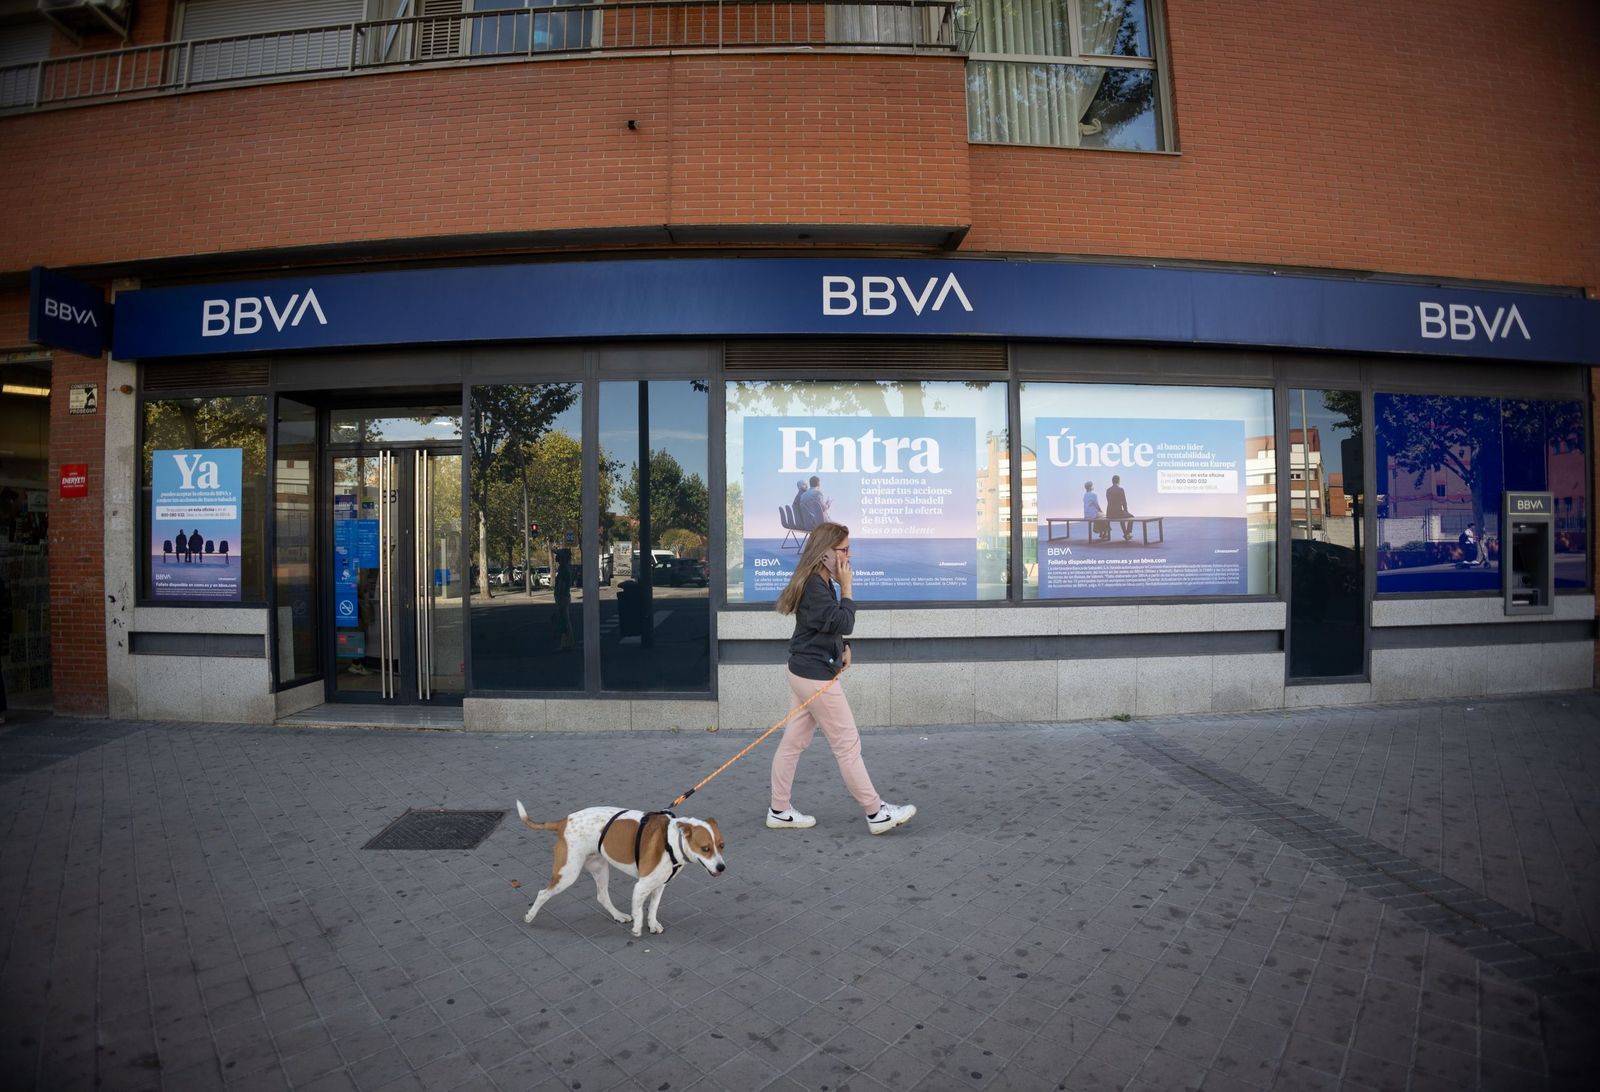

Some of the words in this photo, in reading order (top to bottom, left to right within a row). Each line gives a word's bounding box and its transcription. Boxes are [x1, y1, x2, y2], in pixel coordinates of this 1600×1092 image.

[822, 272, 974, 318] BBVA
[45, 297, 98, 328] BBVA
[201, 287, 328, 338] BBVA
[1419, 301, 1531, 342] BBVA
[778, 427, 944, 474] Entra
[1046, 427, 1154, 468] Únete
[173, 454, 221, 490] Ya
[871, 477, 920, 487] ayudamos
[861, 487, 897, 496] canjear
[912, 487, 953, 496] acciones
[861, 496, 873, 504] de
[904, 496, 944, 504] Sabadell
[1517, 500, 1544, 510] BBVA
[862, 508, 867, 516] y
[869, 507, 904, 516] aceptar
[904, 506, 913, 514] la
[914, 506, 943, 514] oferta
[861, 516, 873, 524] de
[904, 526, 936, 535] cliente
[1047, 547, 1072, 556] BBVA
[754, 558, 780, 566] BBVA
[1068, 558, 1097, 566] disponible
